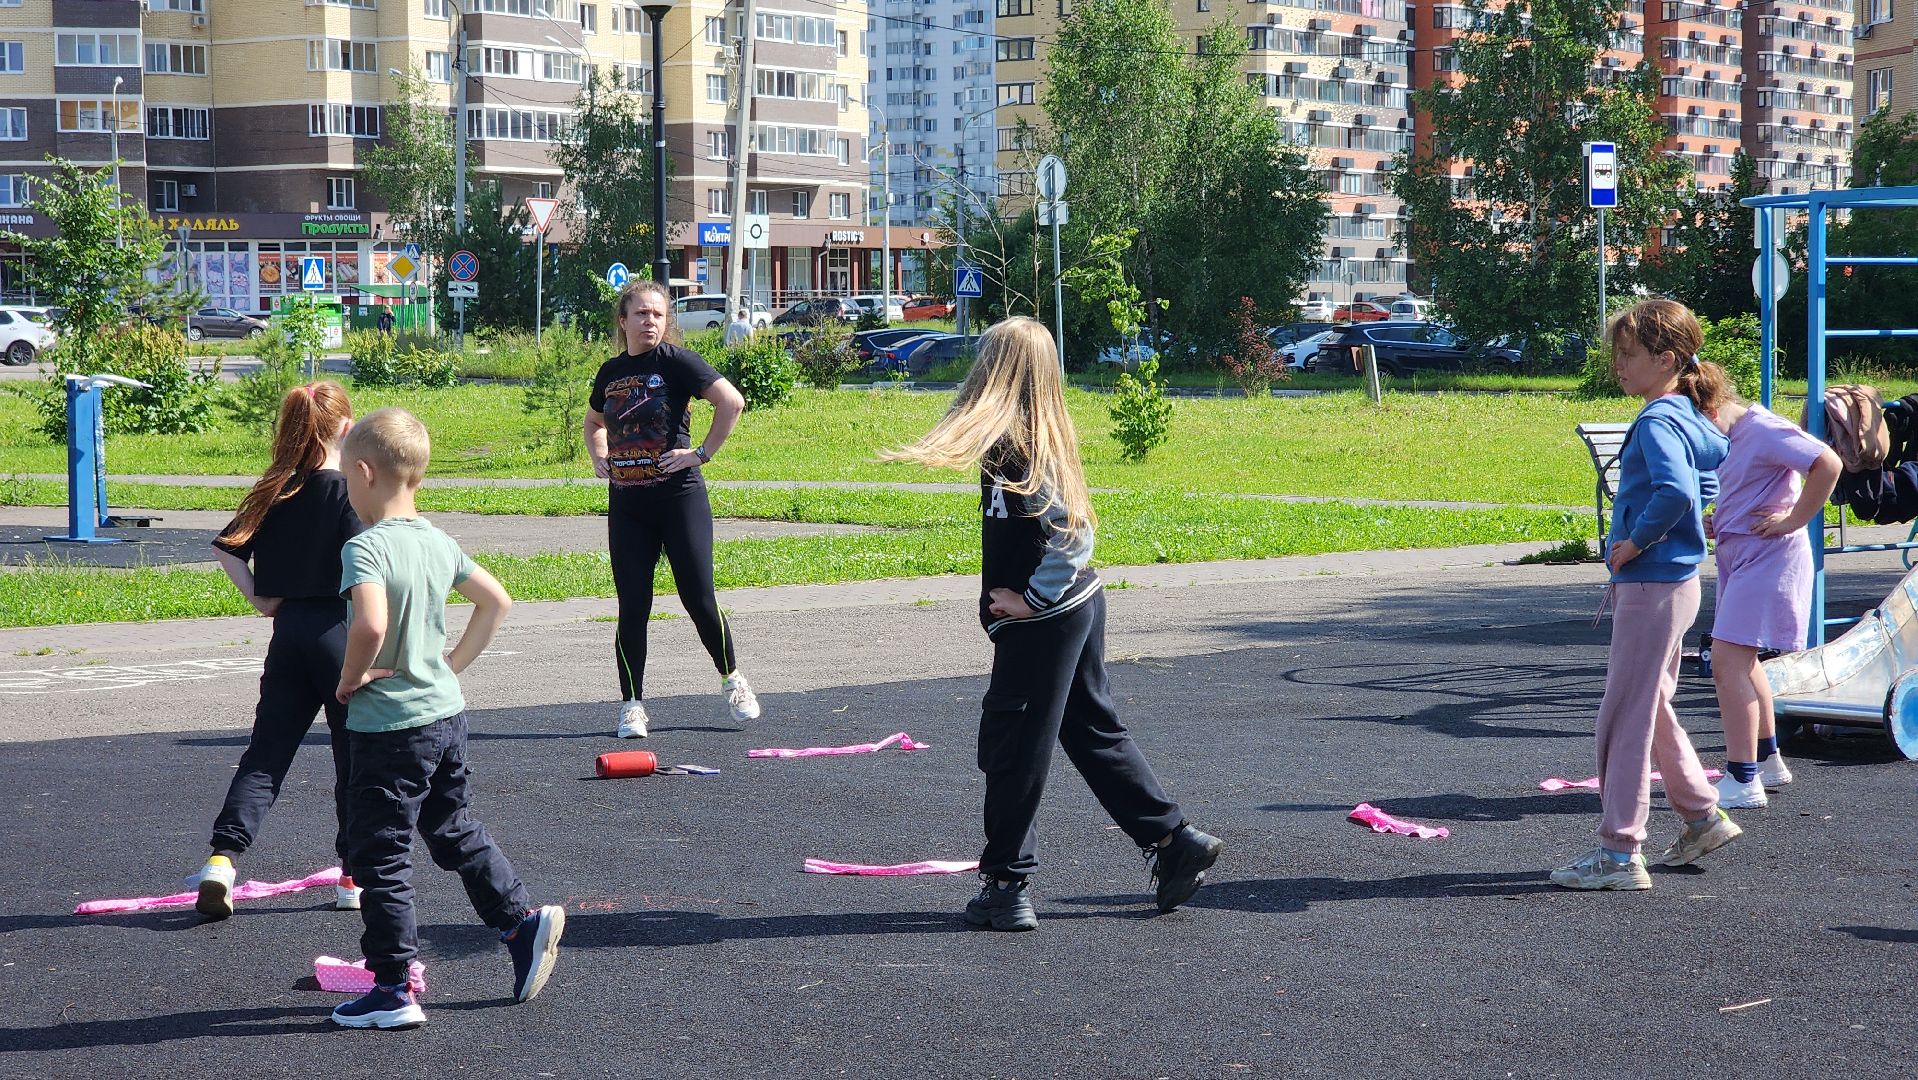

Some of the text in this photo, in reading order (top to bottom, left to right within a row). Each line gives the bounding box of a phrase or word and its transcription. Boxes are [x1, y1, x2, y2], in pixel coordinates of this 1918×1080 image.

[304, 213, 362, 222] ФРУКТЫ ОВОЩИ
[832, 230, 865, 242] ROSTIC'S
[985, 475, 1009, 519] A
